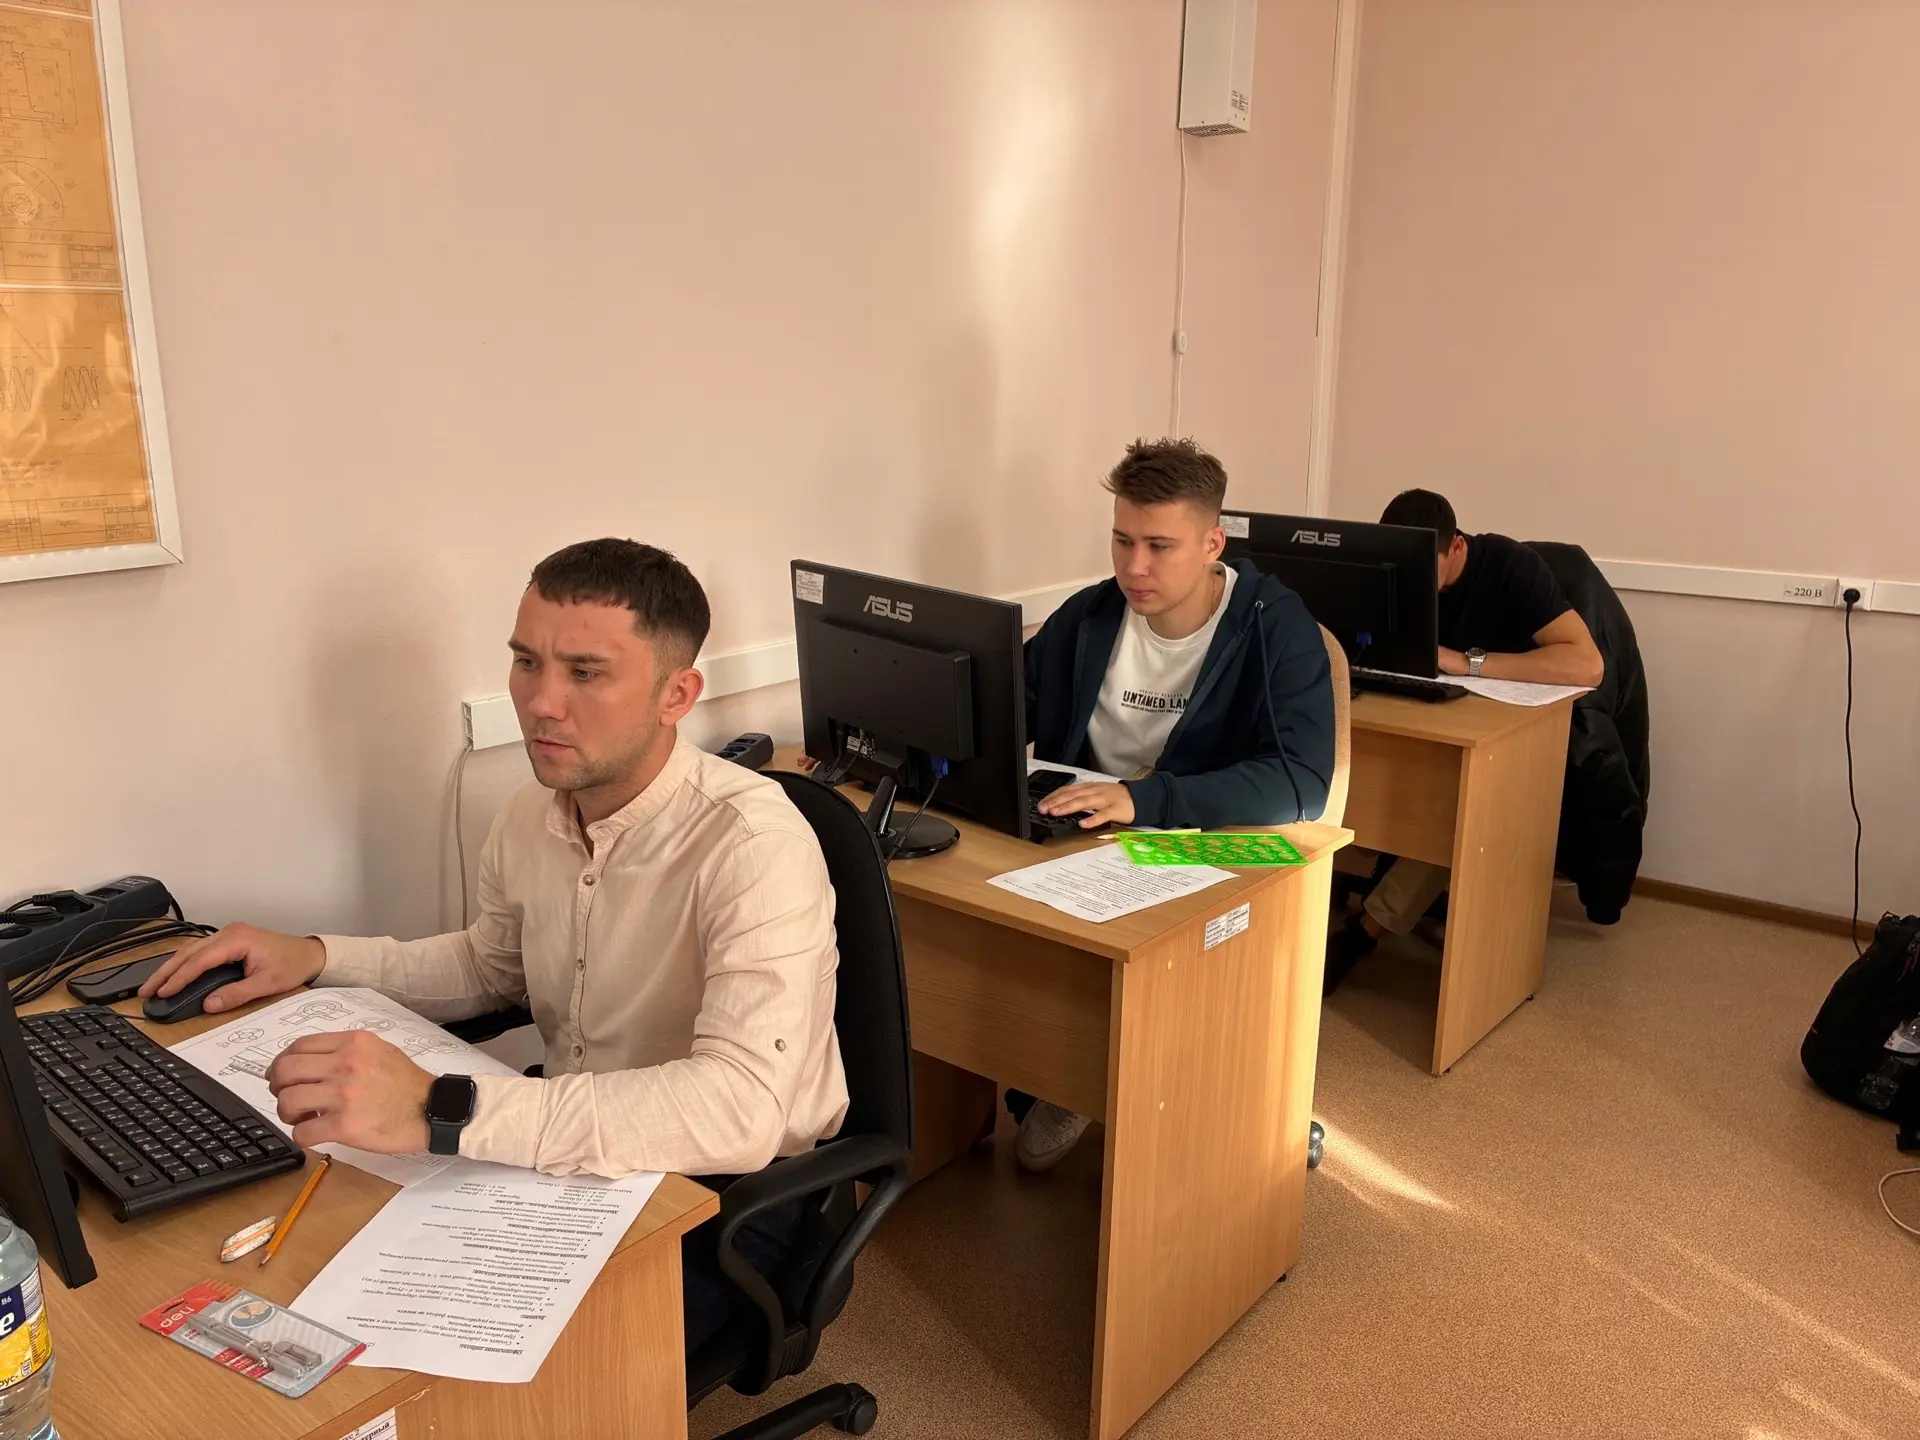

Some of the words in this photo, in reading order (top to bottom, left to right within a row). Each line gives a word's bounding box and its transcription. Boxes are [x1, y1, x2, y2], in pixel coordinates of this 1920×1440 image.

[1291, 529, 1341, 547] ASUS
[1794, 588, 1812, 597] 220
[1815, 589, 1822, 597] В
[863, 595, 914, 623] ASUS
[1123, 690, 1165, 709] UNTAMED
[160, 1306, 195, 1328] deli
